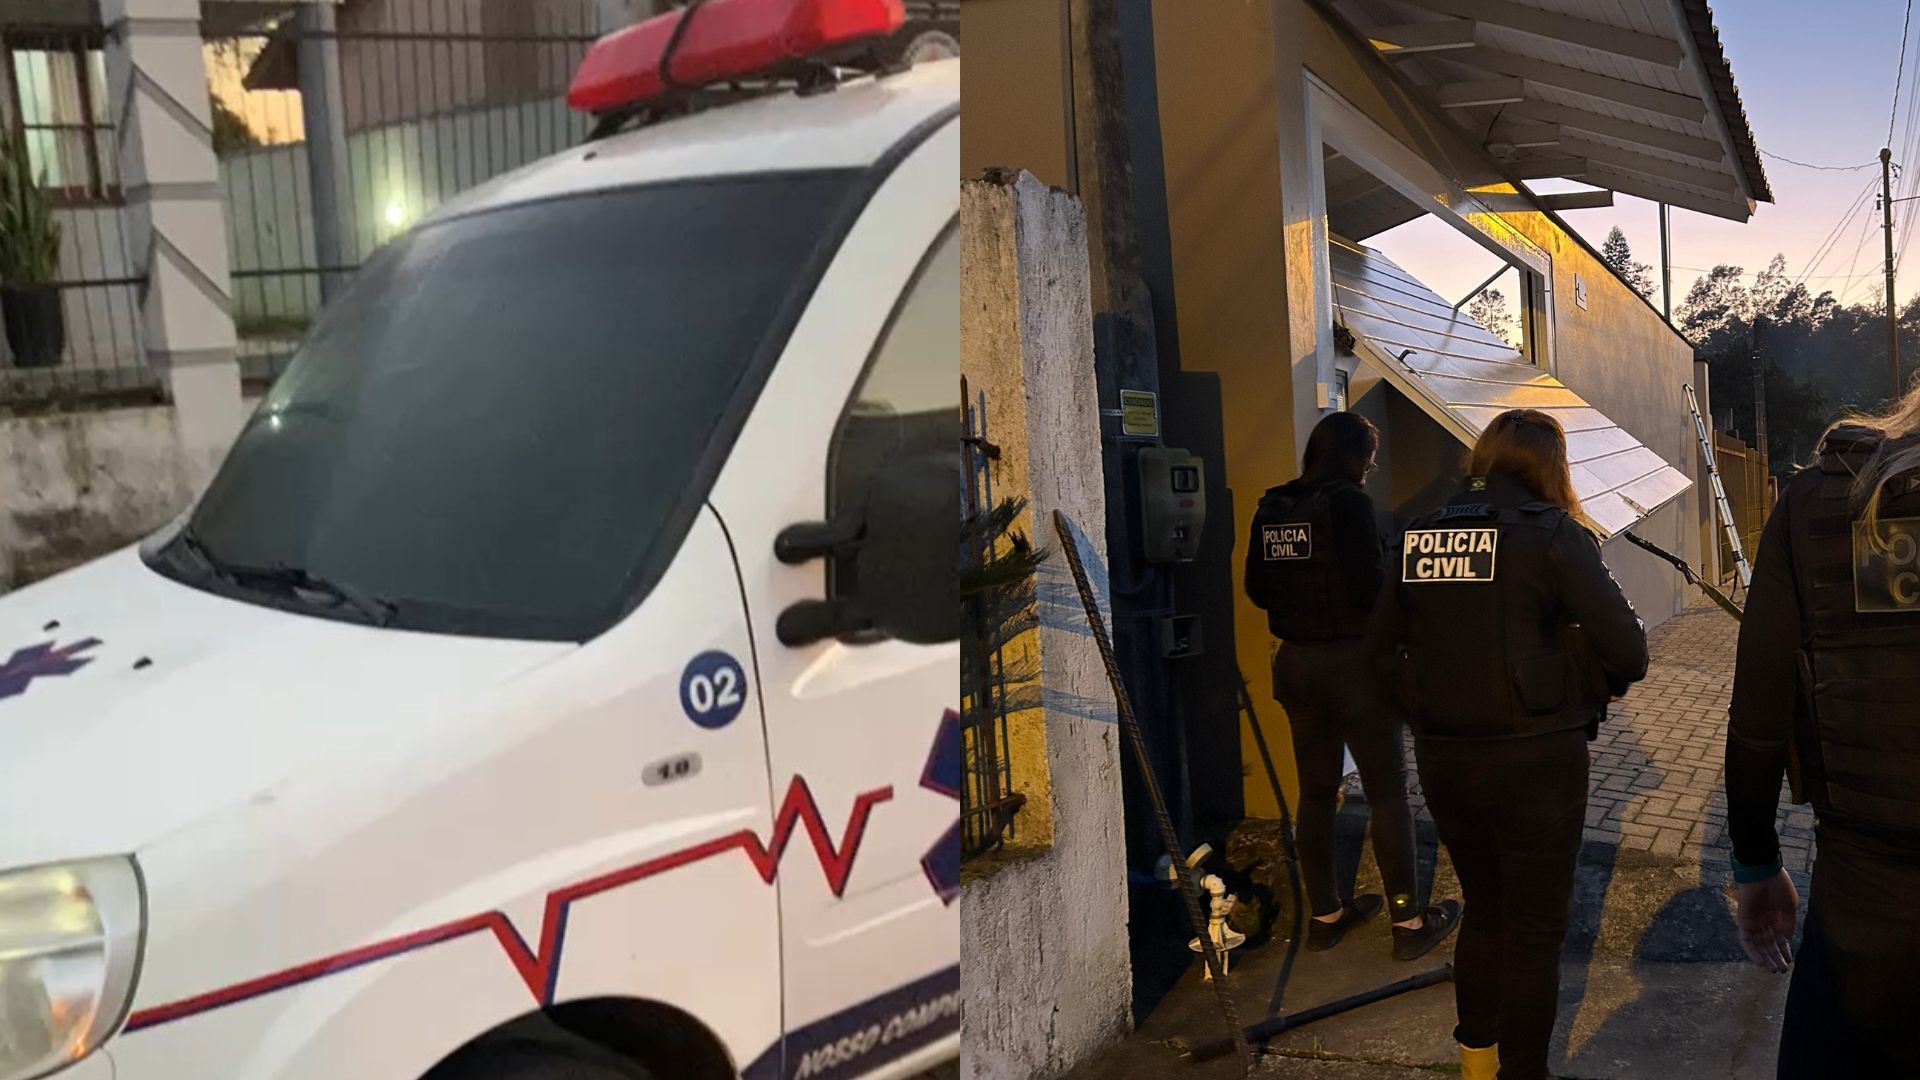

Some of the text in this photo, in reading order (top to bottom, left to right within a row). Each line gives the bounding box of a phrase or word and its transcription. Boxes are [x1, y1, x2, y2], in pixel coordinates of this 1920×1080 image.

[1265, 528, 1308, 543] POLÍCIA
[1406, 532, 1492, 554] POLÍCIA
[1271, 544, 1298, 557] CIVIL
[1416, 557, 1476, 578] CIVIL
[689, 666, 740, 713] 02
[794, 1023, 881, 1080] NOSSO
